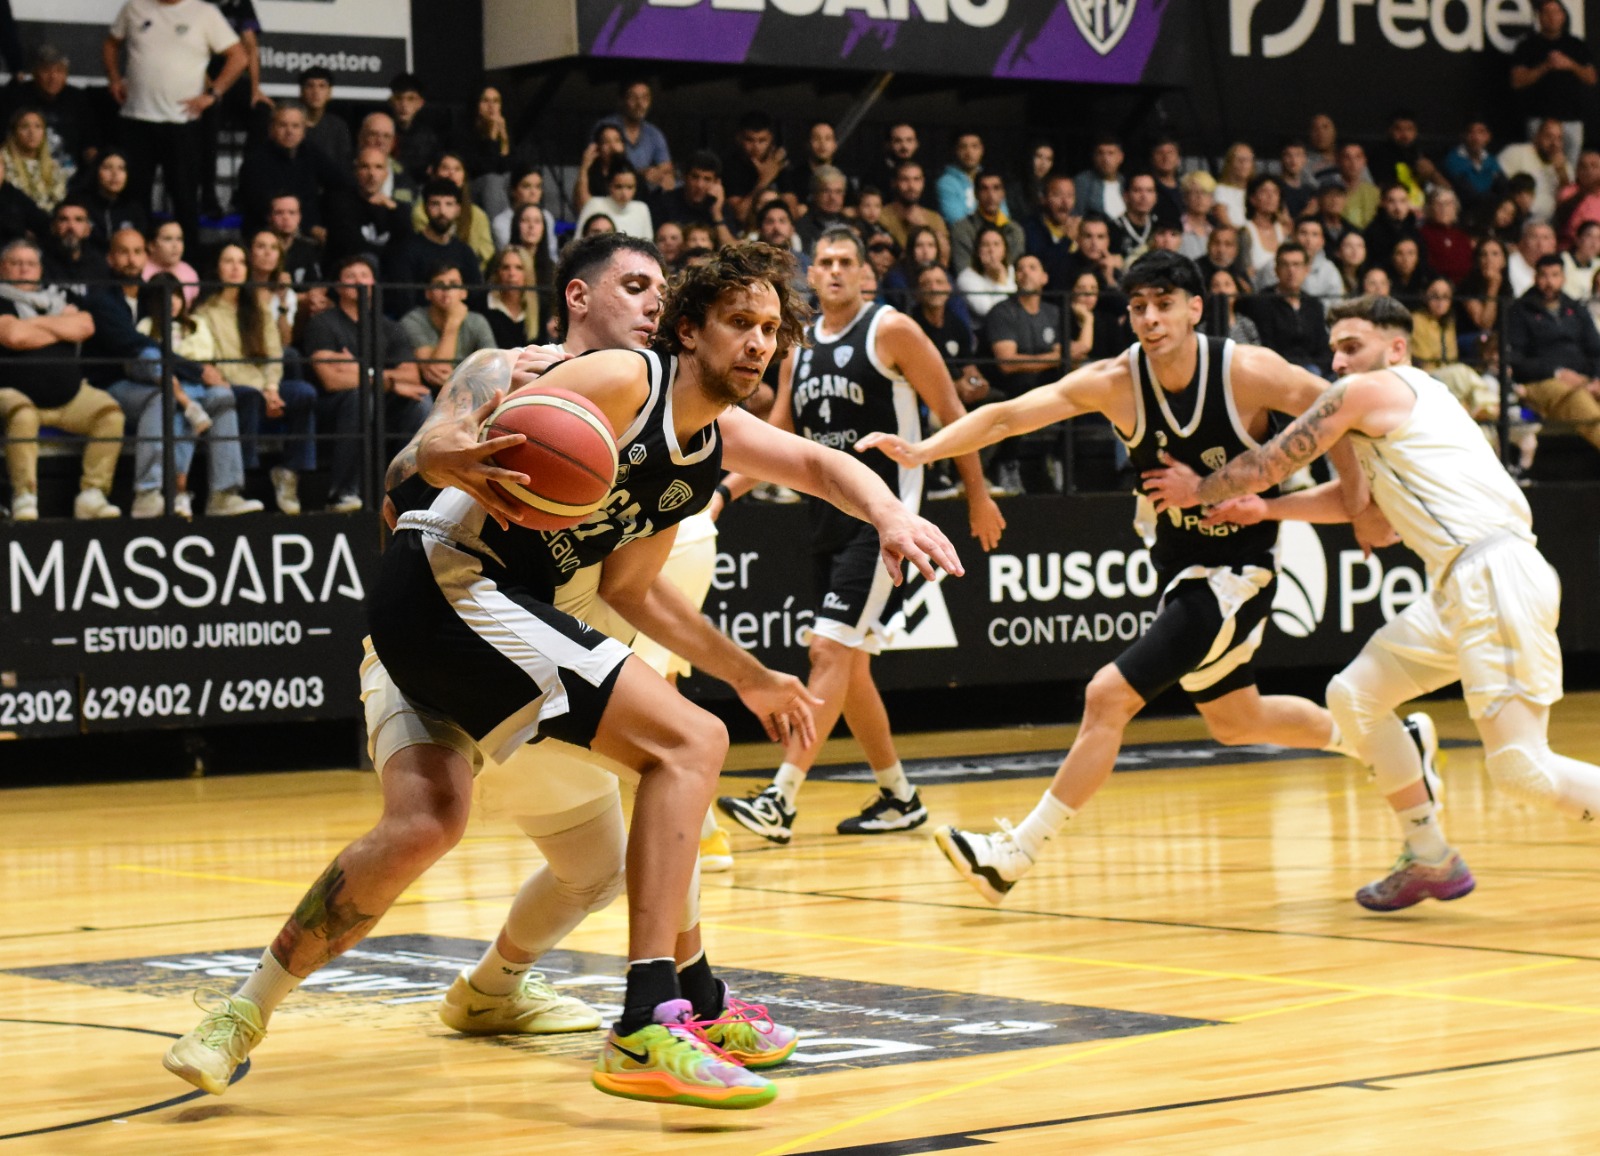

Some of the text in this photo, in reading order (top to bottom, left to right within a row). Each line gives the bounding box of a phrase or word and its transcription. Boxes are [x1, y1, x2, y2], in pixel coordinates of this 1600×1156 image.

[818, 398, 832, 424] 4
[9, 533, 365, 613] MASSARA
[711, 551, 760, 591] er
[84, 620, 301, 653] ESTUDIO JURIDICO
[703, 595, 816, 650] iería
[82, 682, 192, 720] 629602
[219, 675, 325, 712] 629603
